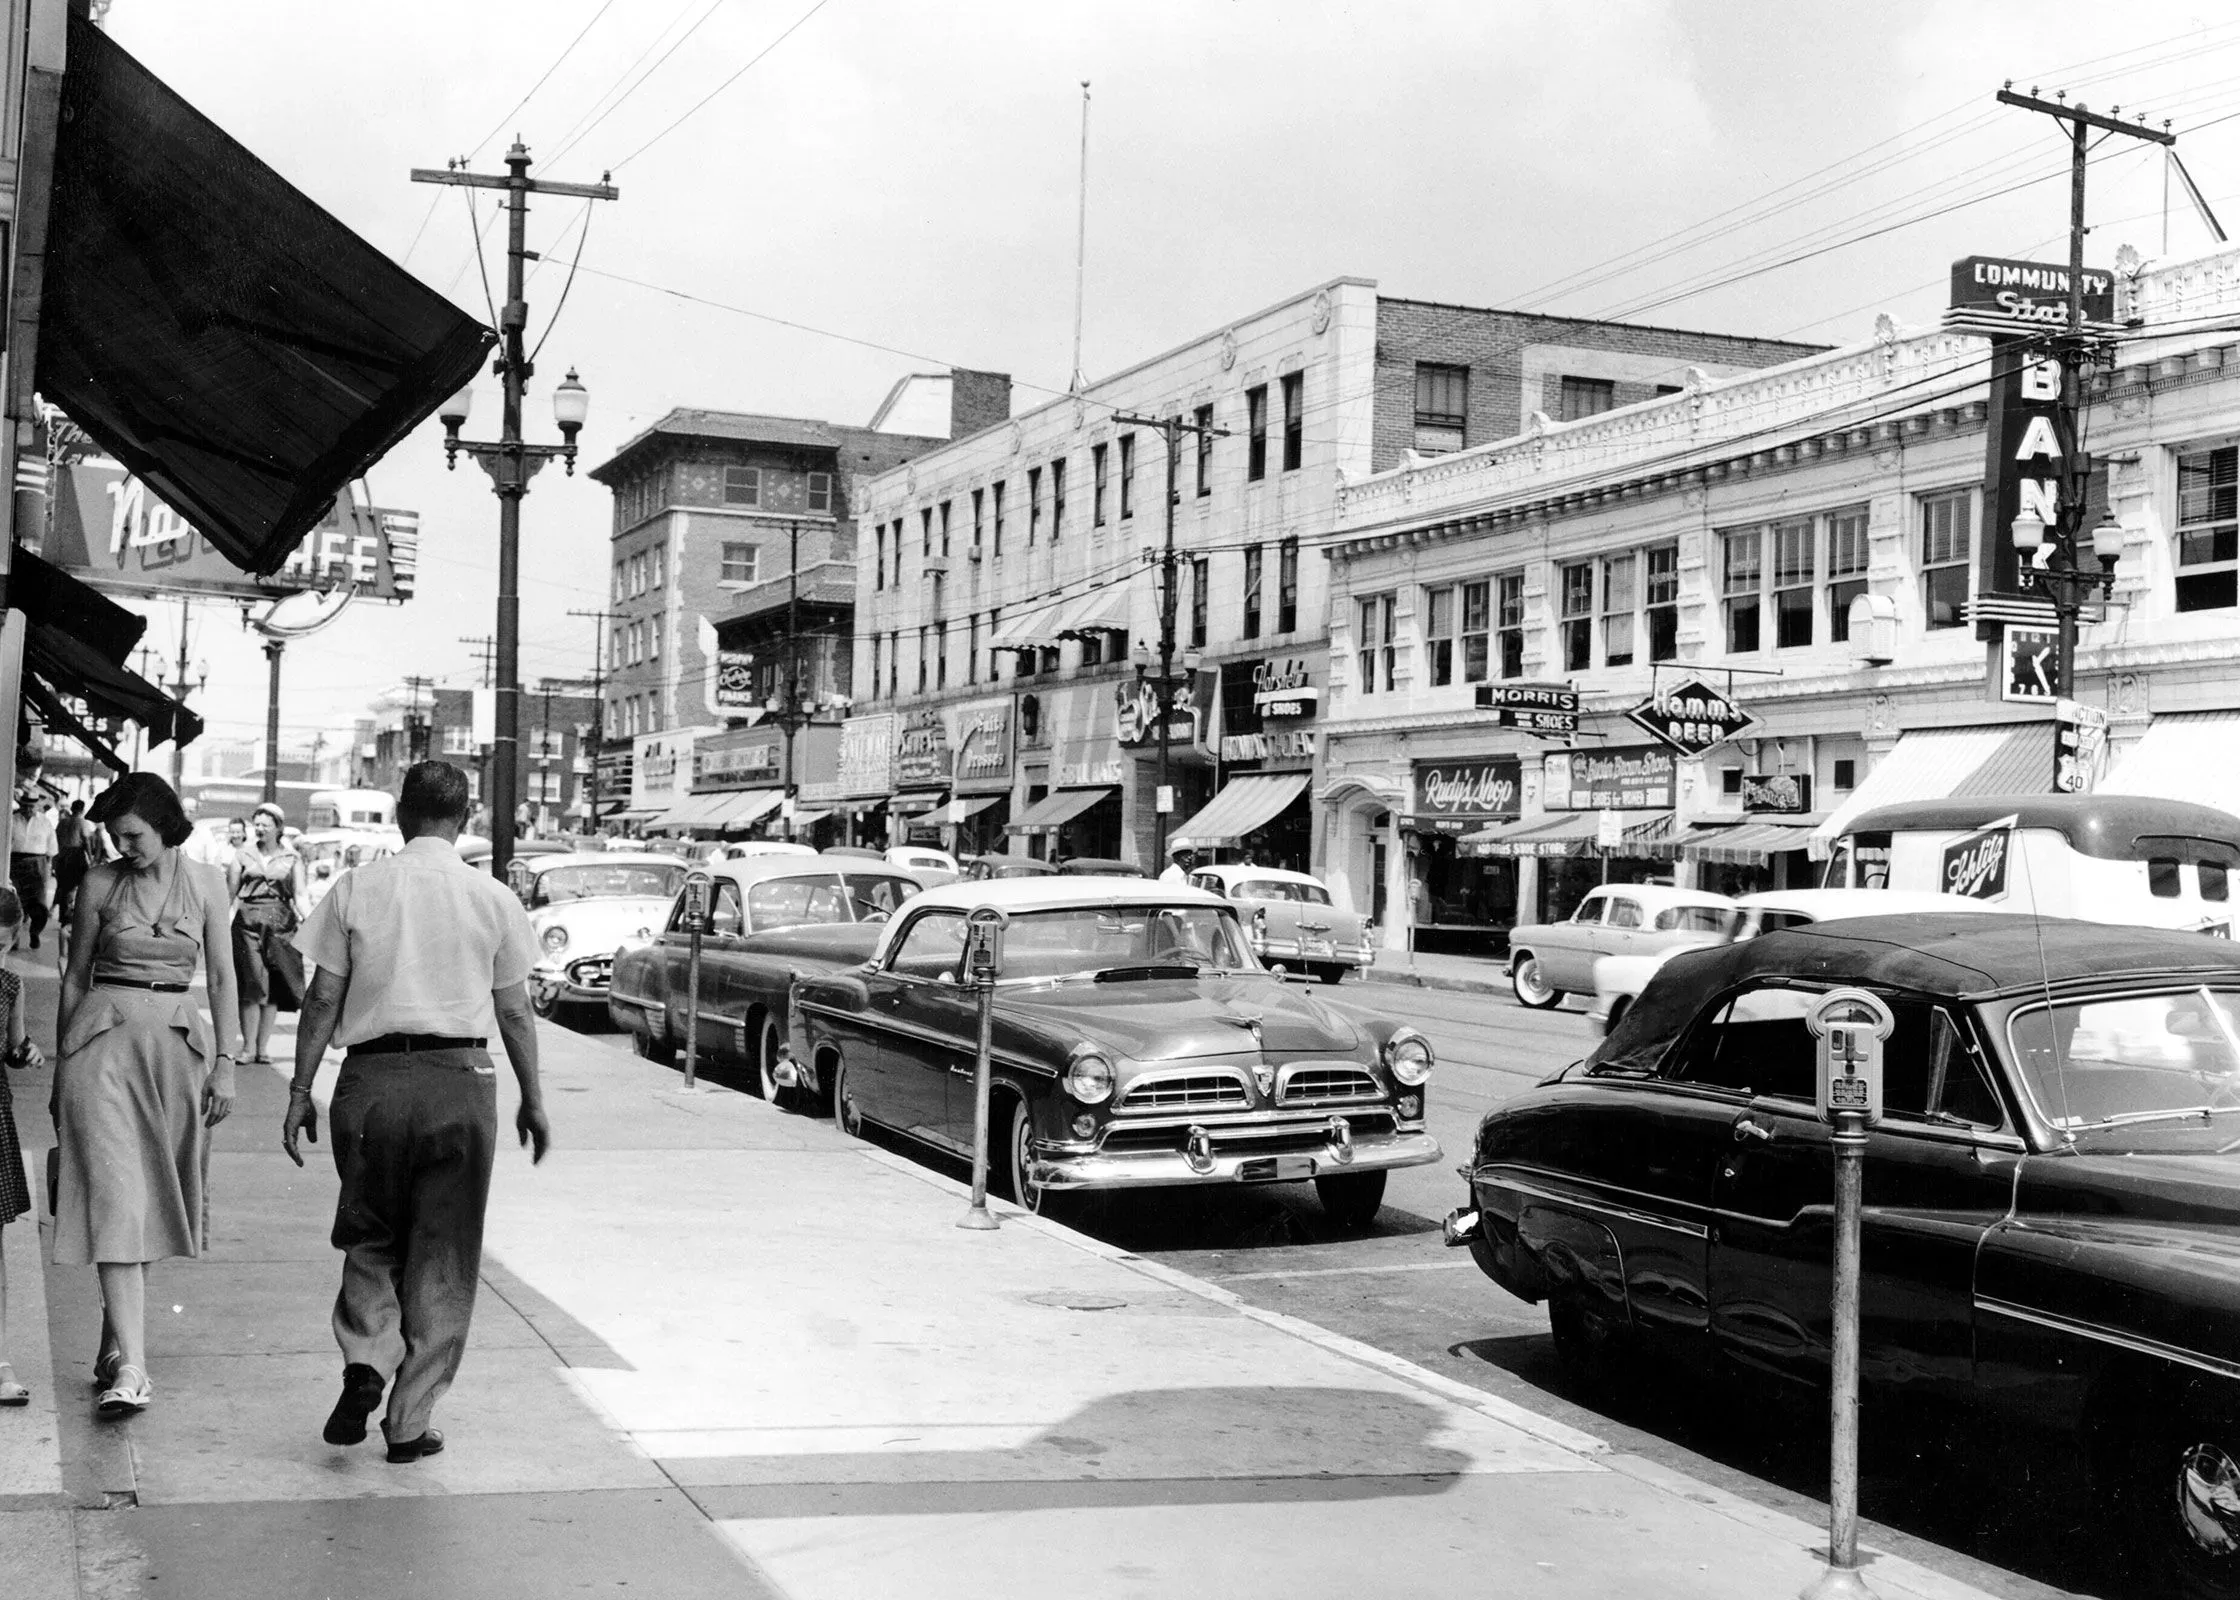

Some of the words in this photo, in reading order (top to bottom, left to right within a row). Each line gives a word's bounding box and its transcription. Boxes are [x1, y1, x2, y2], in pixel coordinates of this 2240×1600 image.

[1974, 263, 2108, 296] COMMUNTY
[1491, 689, 1574, 710] MORRIS
[1535, 713, 1574, 730] SHOES
[1668, 720, 1725, 745] BEER
[1425, 768, 1474, 813] Rudy's
[1470, 767, 1513, 812] Shop
[2065, 775, 2084, 790] 40
